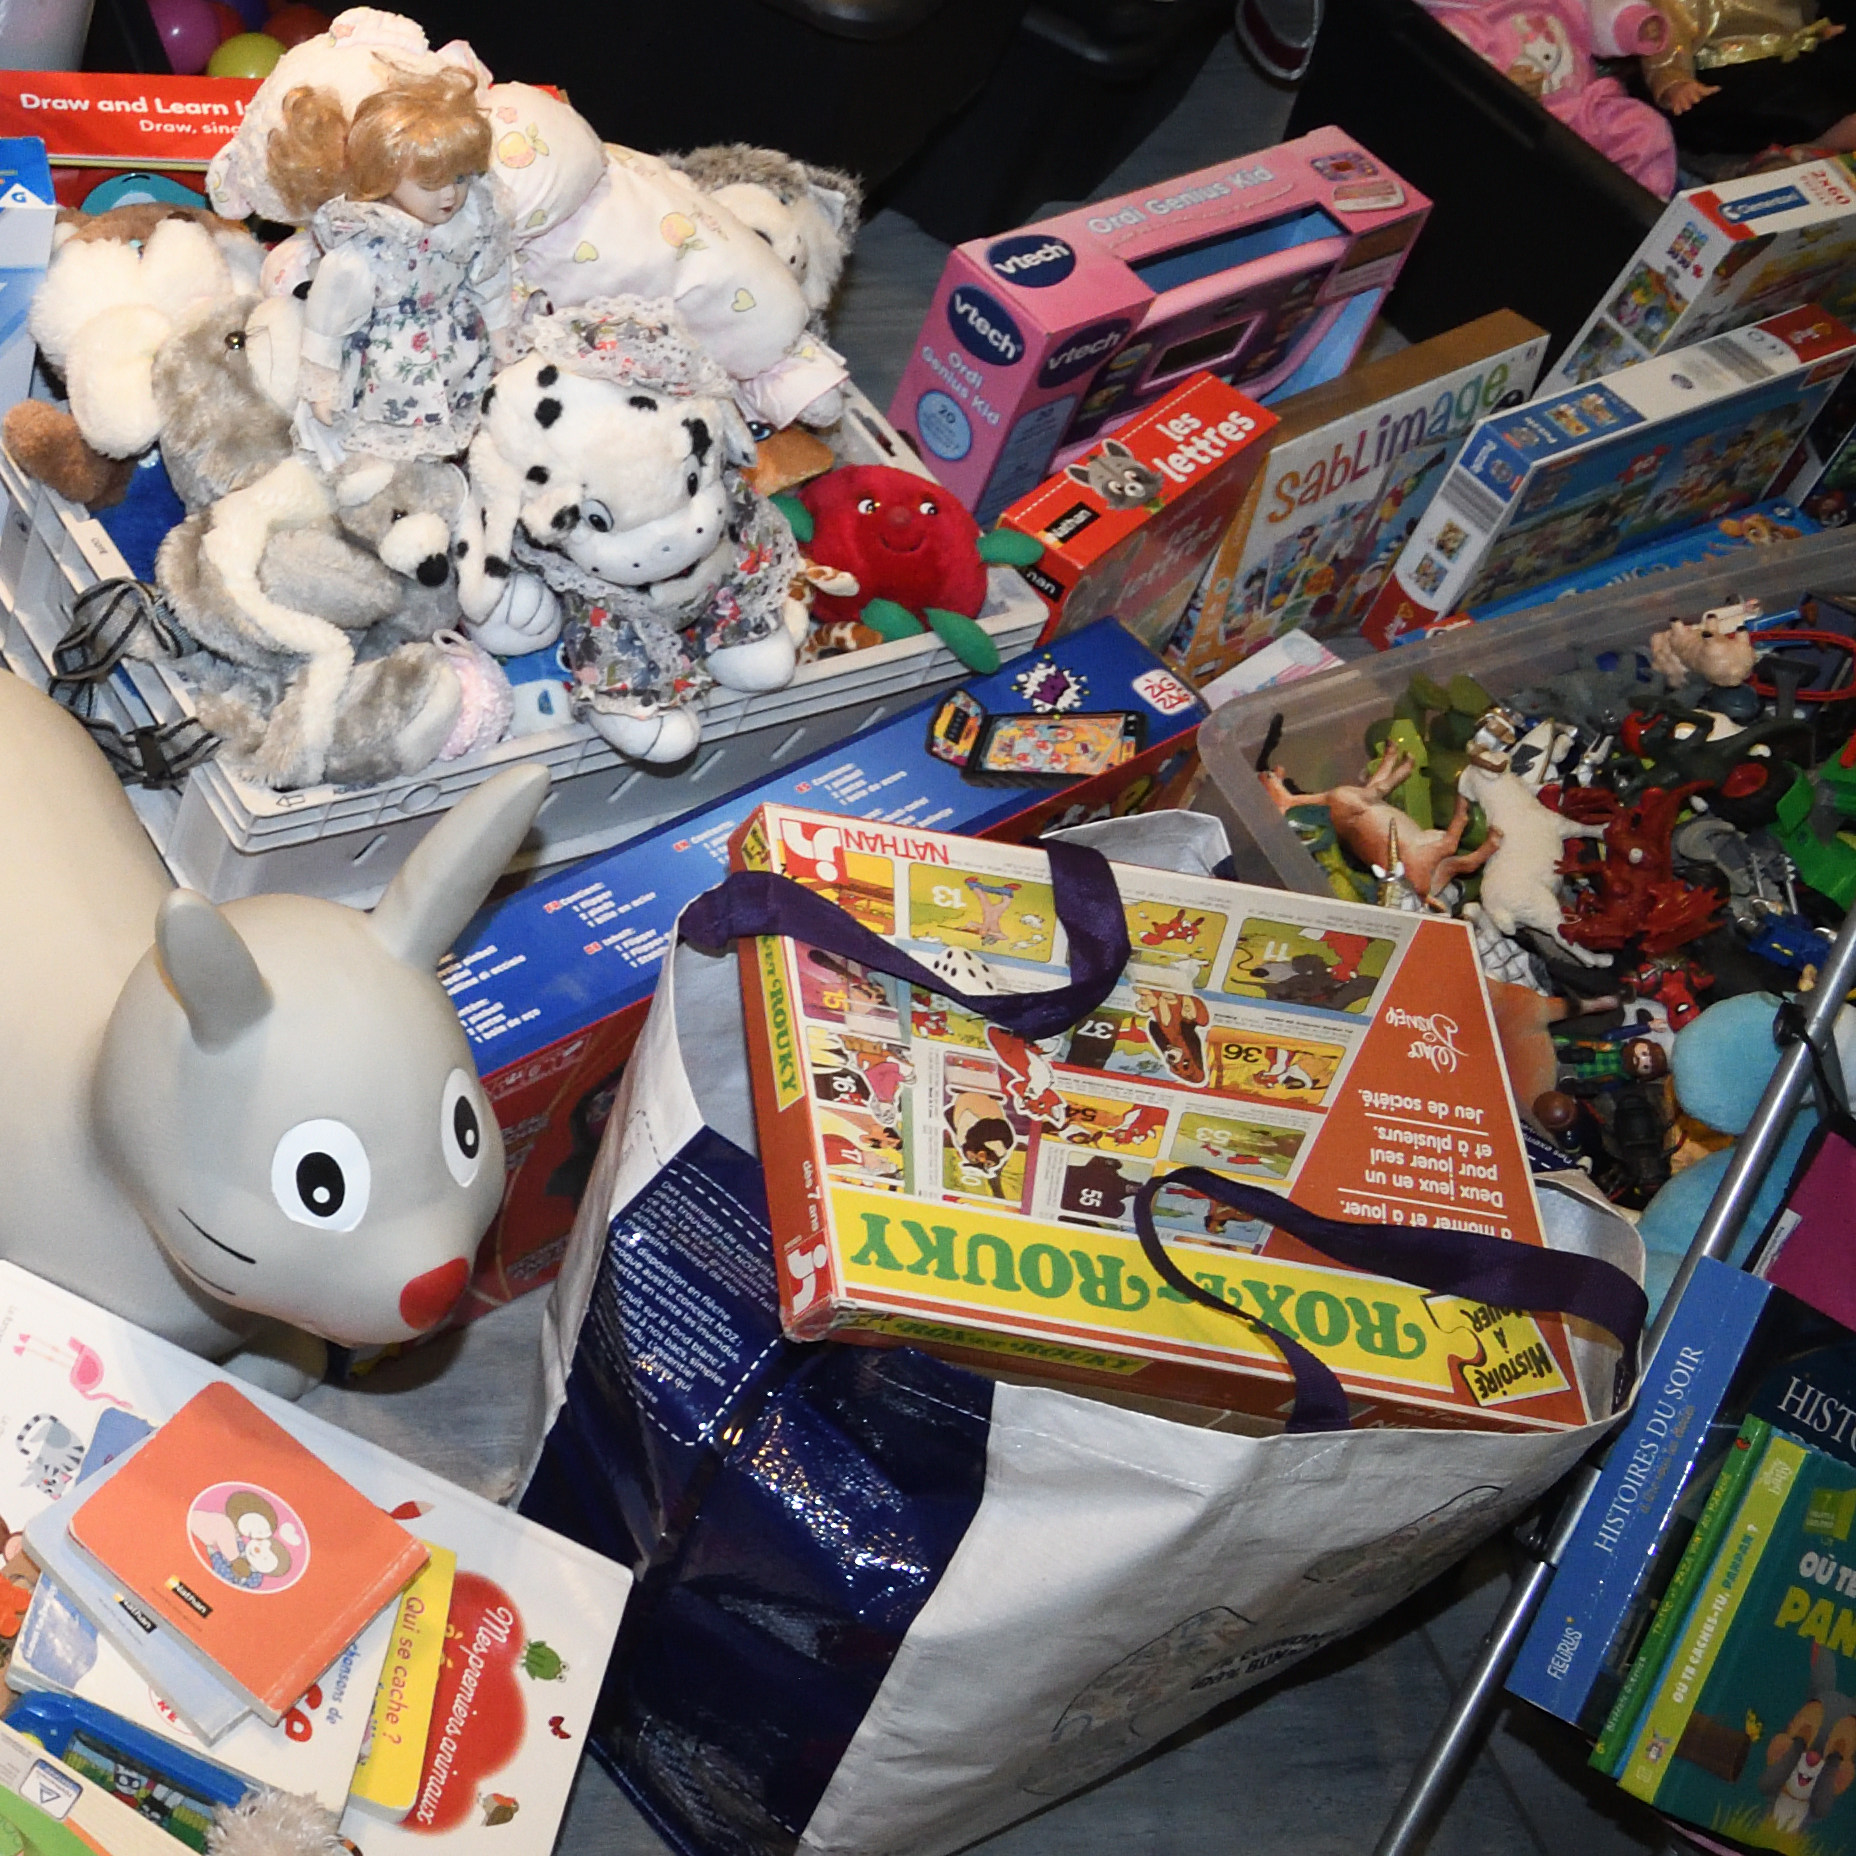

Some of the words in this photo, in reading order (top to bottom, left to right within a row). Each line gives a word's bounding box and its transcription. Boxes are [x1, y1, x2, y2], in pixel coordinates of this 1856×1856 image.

[19, 93, 79, 114] Draw
[95, 94, 148, 115] and
[153, 95, 228, 117] Learn
[993, 240, 1072, 275] vtech
[1086, 207, 1147, 235] Ordi
[1143, 181, 1232, 217] Genius
[1231, 165, 1275, 191] Kid
[951, 292, 1020, 360] vtech
[945, 350, 983, 389] Ordi
[1155, 410, 1203, 442] les
[1151, 410, 1257, 484] lettres
[843, 826, 950, 866] NATHAN
[931, 882, 968, 911] 13
[1075, 1016, 1115, 1041] 37
[1223, 1040, 1264, 1064] 36
[1358, 1089, 1421, 1110] société.
[1428, 1101, 1449, 1117] de
[1455, 1105, 1485, 1124] Jeu
[1373, 1126, 1452, 1150] plusieurs.
[1458, 1141, 1469, 1155] à
[1475, 1143, 1492, 1158] et
[1370, 1148, 1405, 1165] seul
[1410, 1156, 1454, 1177] jouer
[1458, 1163, 1498, 1180] pour
[1365, 1169, 1386, 1186] un
[1392, 1174, 1414, 1190] en
[1418, 1180, 1456, 1200] jeux
[1460, 1186, 1504, 1206] Deux
[848, 1211, 1151, 1314] ROUKY
[636, 1245, 689, 1294] disposition
[687, 1286, 701, 1300] en
[699, 1291, 732, 1323] flèche
[641, 1266, 668, 1291] aussi
[675, 1292, 717, 1332] concept
[715, 1322, 739, 1345] NOZ
[654, 1292, 683, 1320] vente
[680, 1312, 697, 1329] les
[1252, 1281, 1428, 1361] ROX
[667, 1321, 692, 1348] fond
[690, 1341, 718, 1367] blanc
[688, 1355, 727, 1388] simples
[1592, 1438, 1660, 1557] HISTOIRES
[1644, 1397, 1674, 1442] DU
[1663, 1344, 1705, 1400] SOIR
[1799, 1548, 1835, 1587] OÙ
[172, 1582, 210, 1616] Nathan
[401, 1596, 426, 1632] Qui
[396, 1636, 414, 1661] se
[1546, 1624, 1583, 1682] FLEURUS
[385, 1665, 409, 1726] cache
[445, 1644, 485, 1736] premiers
[1671, 1680, 1688, 1704] OÙ
[382, 1731, 402, 1746] ?
[417, 1736, 459, 1826] animaux
